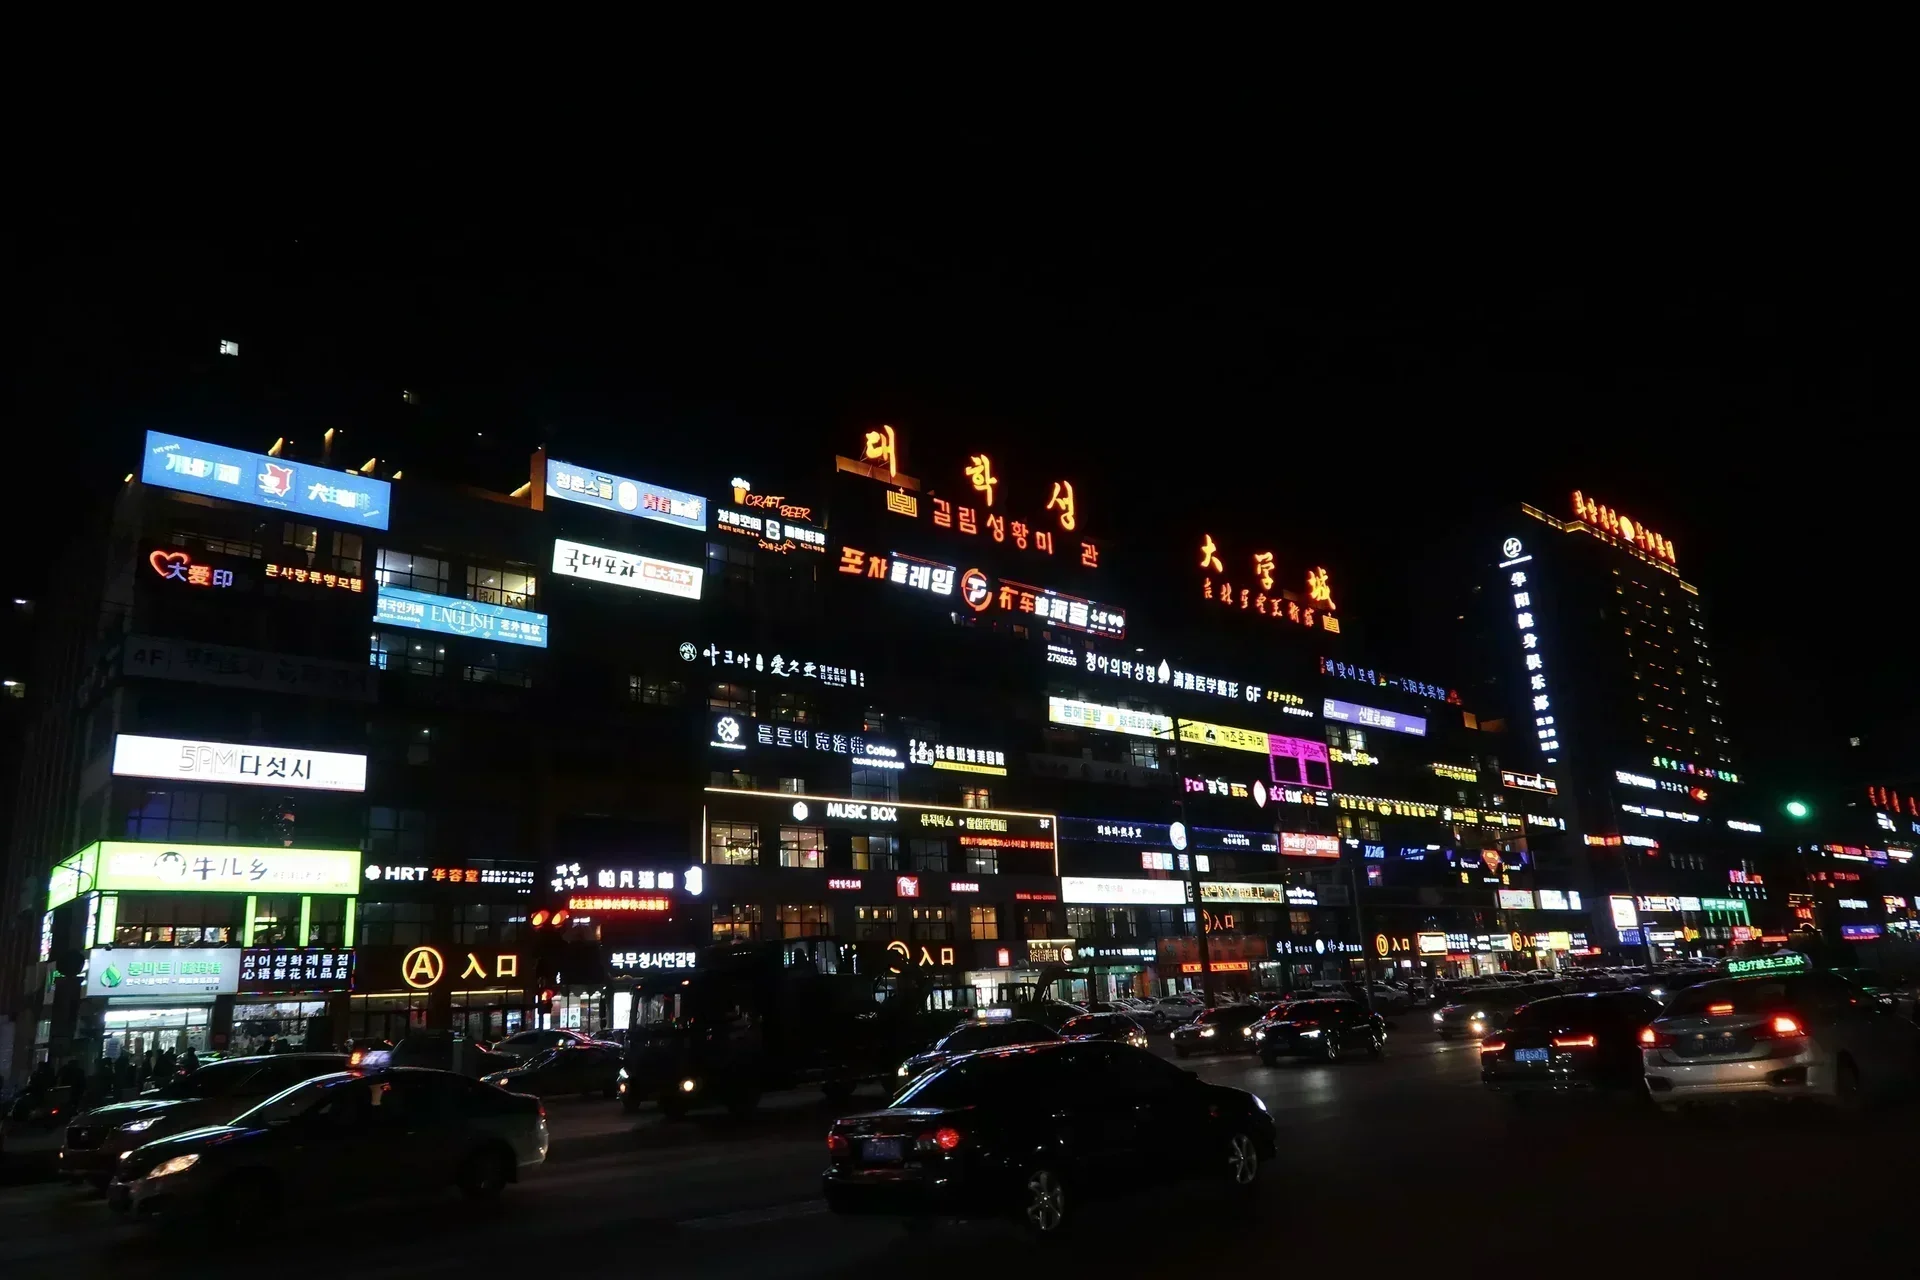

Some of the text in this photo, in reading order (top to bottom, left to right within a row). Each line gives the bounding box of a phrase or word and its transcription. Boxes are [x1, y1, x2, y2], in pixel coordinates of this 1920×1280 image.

[745, 494, 785, 509] CRAFT
[779, 504, 811, 521] BEER
[564, 548, 638, 577] 국대포차
[1201, 534, 1336, 610] 大学城
[377, 599, 424, 616] 외국인카페
[431, 605, 494, 630] ENGLISH
[1047, 652, 1077, 667] 2750555
[1245, 685, 1261, 702] 6F
[866, 744, 897, 758] Coffee
[239, 754, 312, 779] 다섯시
[827, 803, 897, 821] MUSIC BOX
[1040, 819, 1050, 829] 3F
[192, 857, 268, 881] 牛儿乡
[385, 866, 429, 880] HRT
[432, 868, 478, 883] 华容堂
[1213, 914, 1235, 931] 入口
[1392, 937, 1410, 951] 入口
[243, 954, 349, 968] 심어생화례물점
[919, 947, 954, 967] 入口
[1728, 955, 1804, 972] 做足疗就去三点水
[242, 968, 348, 980] 心语鲜花礼品店
[410, 953, 435, 980] A
[460, 954, 518, 980] 入口
